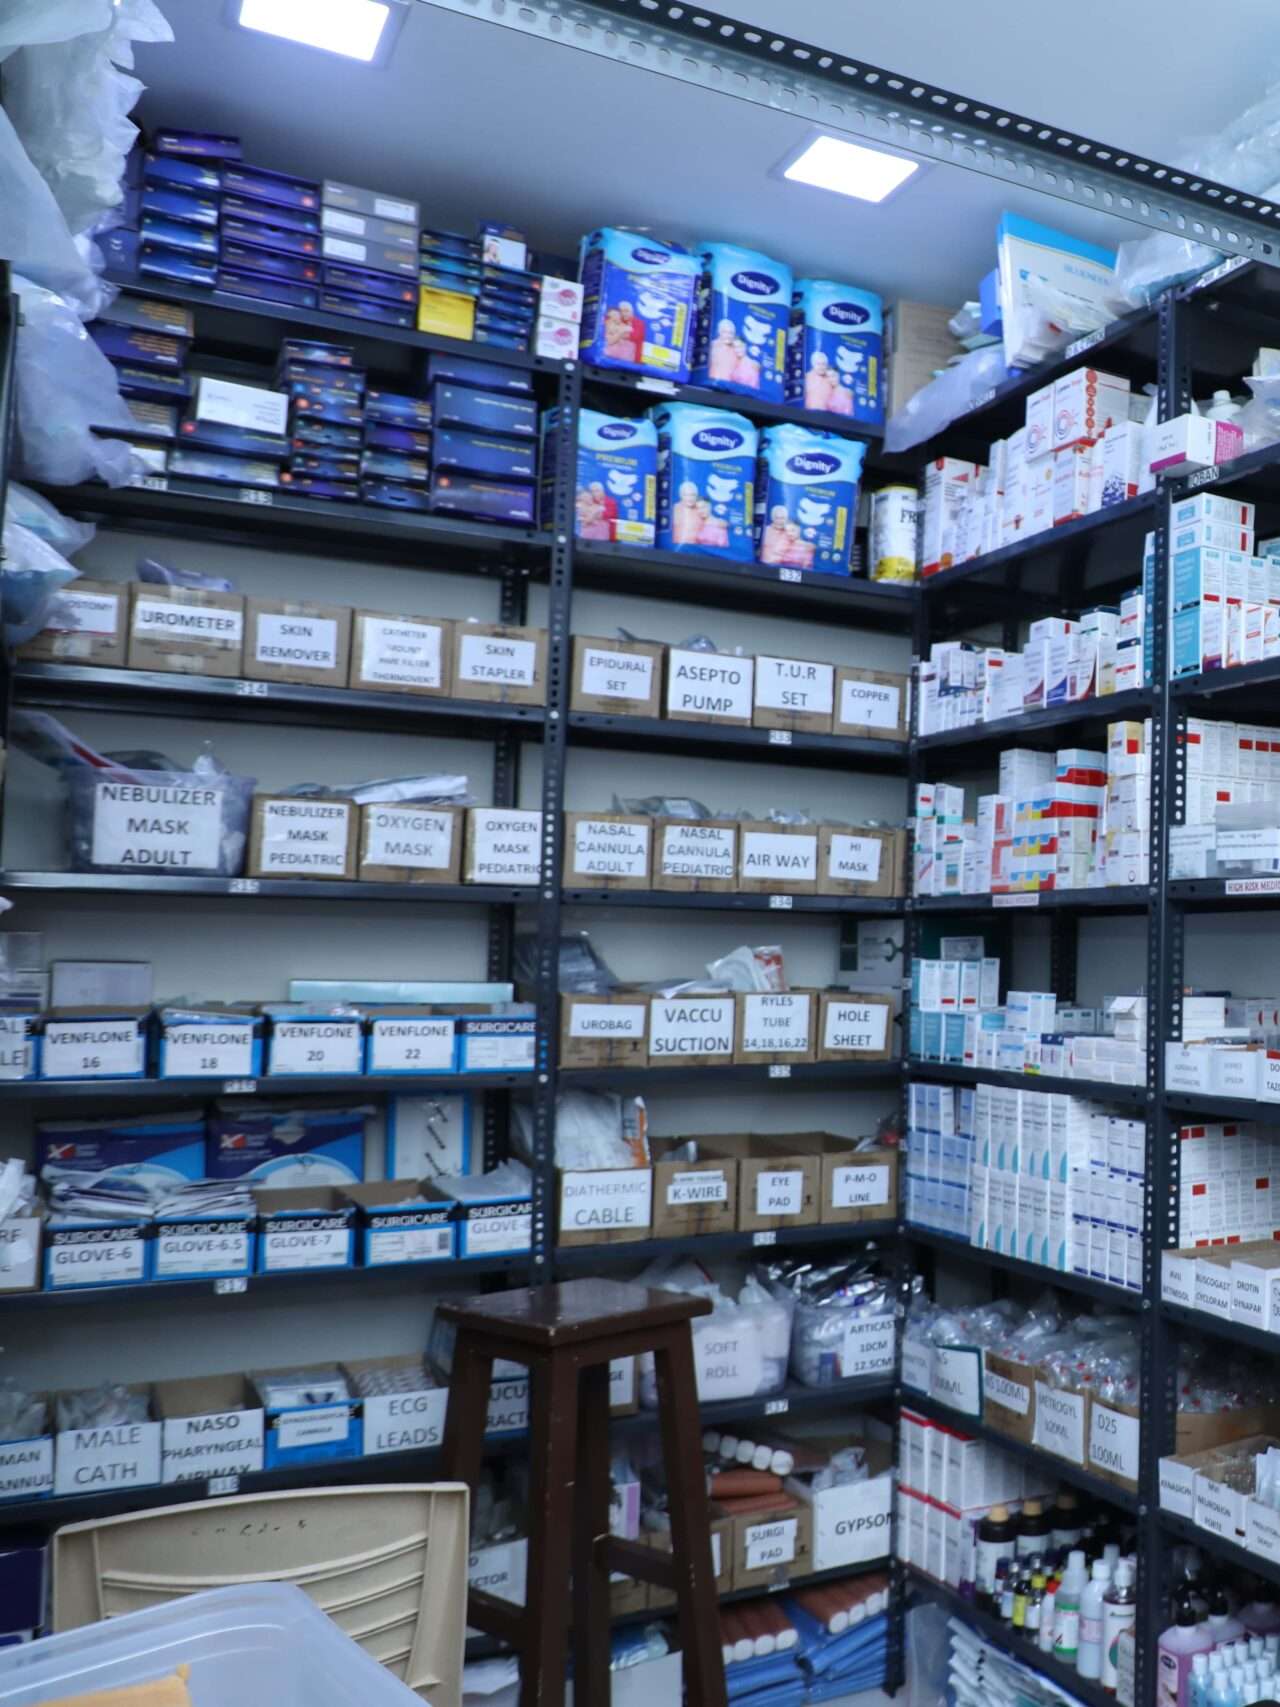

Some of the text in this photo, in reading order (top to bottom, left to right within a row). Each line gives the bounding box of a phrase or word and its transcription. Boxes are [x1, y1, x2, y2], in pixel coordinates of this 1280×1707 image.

[736, 274, 774, 294] Dignity
[828, 306, 865, 323] Dignity
[699, 432, 737, 449] Dignity
[793, 457, 834, 474] Dignity
[141, 610, 237, 632] UROMETER
[280, 623, 314, 638] SKIN
[260, 644, 331, 664] REMOVER
[484, 643, 516, 657] SKIN
[471, 663, 527, 681] STAPLER
[589, 655, 648, 673] EPIDURAL
[775, 661, 817, 681] T.U.R
[676, 664, 742, 685] ASEPTO
[606, 679, 626, 692] SET
[682, 694, 733, 712] PUMP
[781, 691, 808, 707] SET
[850, 687, 891, 703] COPPER
[103, 784, 218, 807] NEBULIZER
[268, 803, 345, 819] NEBULIZER
[127, 817, 190, 836] MASK
[376, 814, 446, 833] OXYGEN
[485, 820, 538, 833] OXYGEN
[587, 823, 636, 838] NASAL
[287, 828, 329, 843] MASK
[680, 826, 724, 841] NASAL
[385, 840, 434, 858] MASK
[493, 842, 530, 856] MASK
[576, 841, 646, 856] CANNULA
[666, 843, 731, 859] CANNULA
[120, 849, 192, 867] ADULT
[269, 850, 344, 867] PEDIATRIC
[746, 852, 811, 869] AIR WAY
[838, 859, 869, 873] MASK
[478, 862, 542, 875] PEDIATRIC
[587, 860, 634, 874] ADULT
[663, 861, 735, 877] PEDIATRIC
[761, 996, 793, 1007] RYLES
[664, 1007, 722, 1023] VACCU
[762, 1016, 791, 1028] TUBE
[838, 1009, 871, 1023] HOLE
[378, 1024, 449, 1038] VENFLONE
[466, 1020, 535, 1034] SURGICARE
[581, 1018, 633, 1031] UROBAG
[48, 1030, 134, 1046] VENFLONE
[168, 1031, 250, 1047] VENFLONE
[279, 1026, 354, 1040] VENFLONE
[833, 1034, 872, 1047] SHEET
[654, 1036, 730, 1053] SUCTION
[744, 1037, 808, 1050] 14,18,16,22
[306, 1050, 325, 1062] 20
[404, 1048, 421, 1060] 22
[81, 1056, 102, 1069] 16
[199, 1057, 218, 1070] 18
[564, 1181, 647, 1197] DIATHERMIC
[771, 1176, 791, 1187] EYE
[672, 1185, 723, 1200] K-WIRE
[768, 1195, 791, 1207] PAD
[469, 1204, 532, 1218] SURGICAR
[575, 1207, 634, 1225] CABLE
[266, 1217, 348, 1233] SURGICARE
[371, 1212, 449, 1227] SURGICARE
[54, 1228, 139, 1244] SURGICARE
[160, 1220, 248, 1237] SURGICARE
[163, 1236, 243, 1254] GLOVE-6.5
[269, 1234, 332, 1249] GLOVE-7
[55, 1246, 132, 1264] GLOVE-6
[704, 1339, 739, 1355] SOFT
[859, 1340, 888, 1353] 10CM
[705, 1364, 739, 1379] ROLL
[388, 1396, 428, 1416] ECG
[186, 1415, 240, 1435] NASO
[75, 1426, 142, 1449] MALE
[376, 1427, 440, 1450] LEADS
[163, 1437, 263, 1461] PHARYNGEAL
[1092, 1446, 1126, 1471] 100ML
[74, 1462, 138, 1486] CATH
[760, 1547, 783, 1560] PAD
